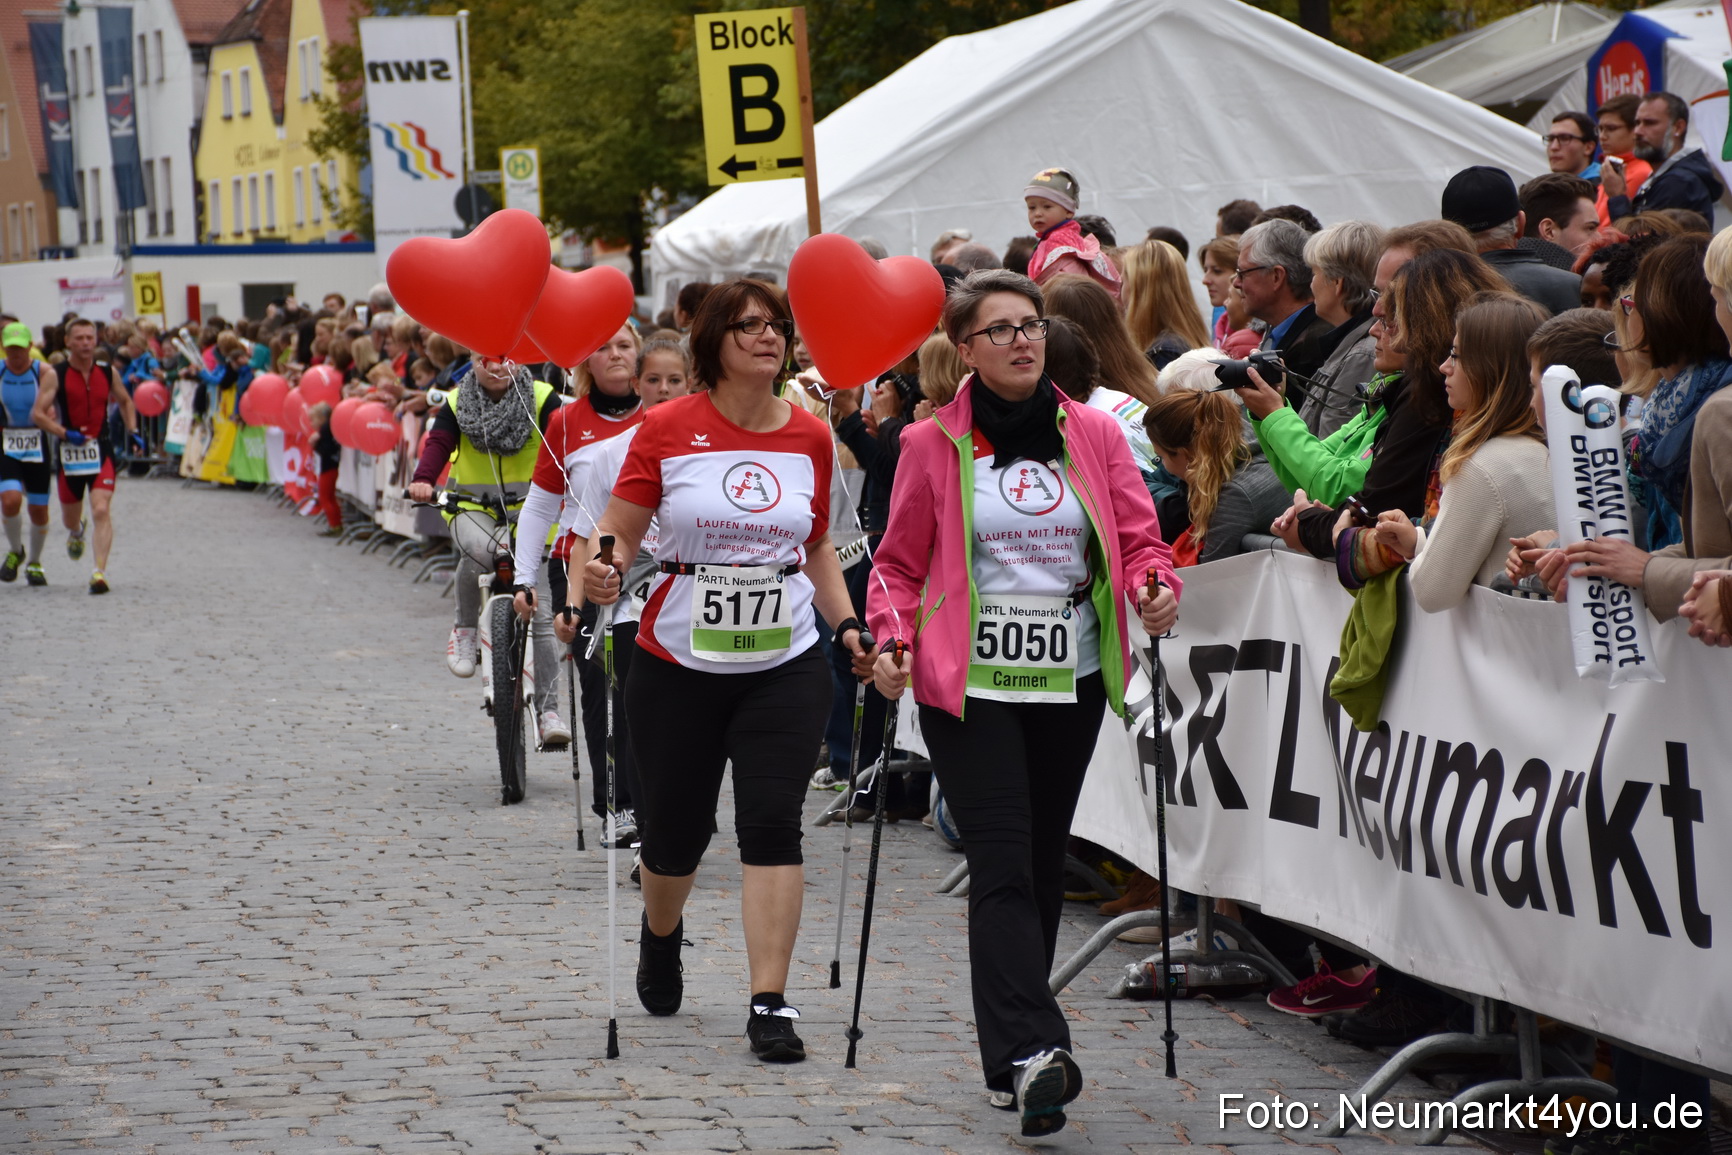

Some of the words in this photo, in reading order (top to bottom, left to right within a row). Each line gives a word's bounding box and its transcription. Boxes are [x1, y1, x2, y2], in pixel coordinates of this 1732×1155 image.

[709, 16, 795, 51] Block
[728, 63, 786, 146] B
[141, 285, 156, 306] D
[8, 436, 38, 450] 2029
[64, 447, 97, 462] 3110
[1591, 448, 1628, 521] BMW
[705, 543, 778, 560] Leistungsdiagnostik
[757, 537, 782, 549] Röschl
[989, 547, 1002, 555] Dr.
[1003, 544, 1023, 552] Heck
[1046, 542, 1073, 551] Röschl
[995, 554, 1072, 566] istungsdiagnostik
[697, 574, 730, 586] PARTL
[732, 576, 775, 586] Neumarkt
[703, 588, 782, 626] 5177
[979, 605, 1006, 616] ARTL
[1009, 606, 1059, 618] Neumarkt
[734, 635, 755, 649] Elli
[976, 621, 1068, 663] 5050
[993, 671, 1048, 688] Carmen
[1130, 639, 1320, 829] ARTL
[1322, 656, 1713, 949] Neumarkt
